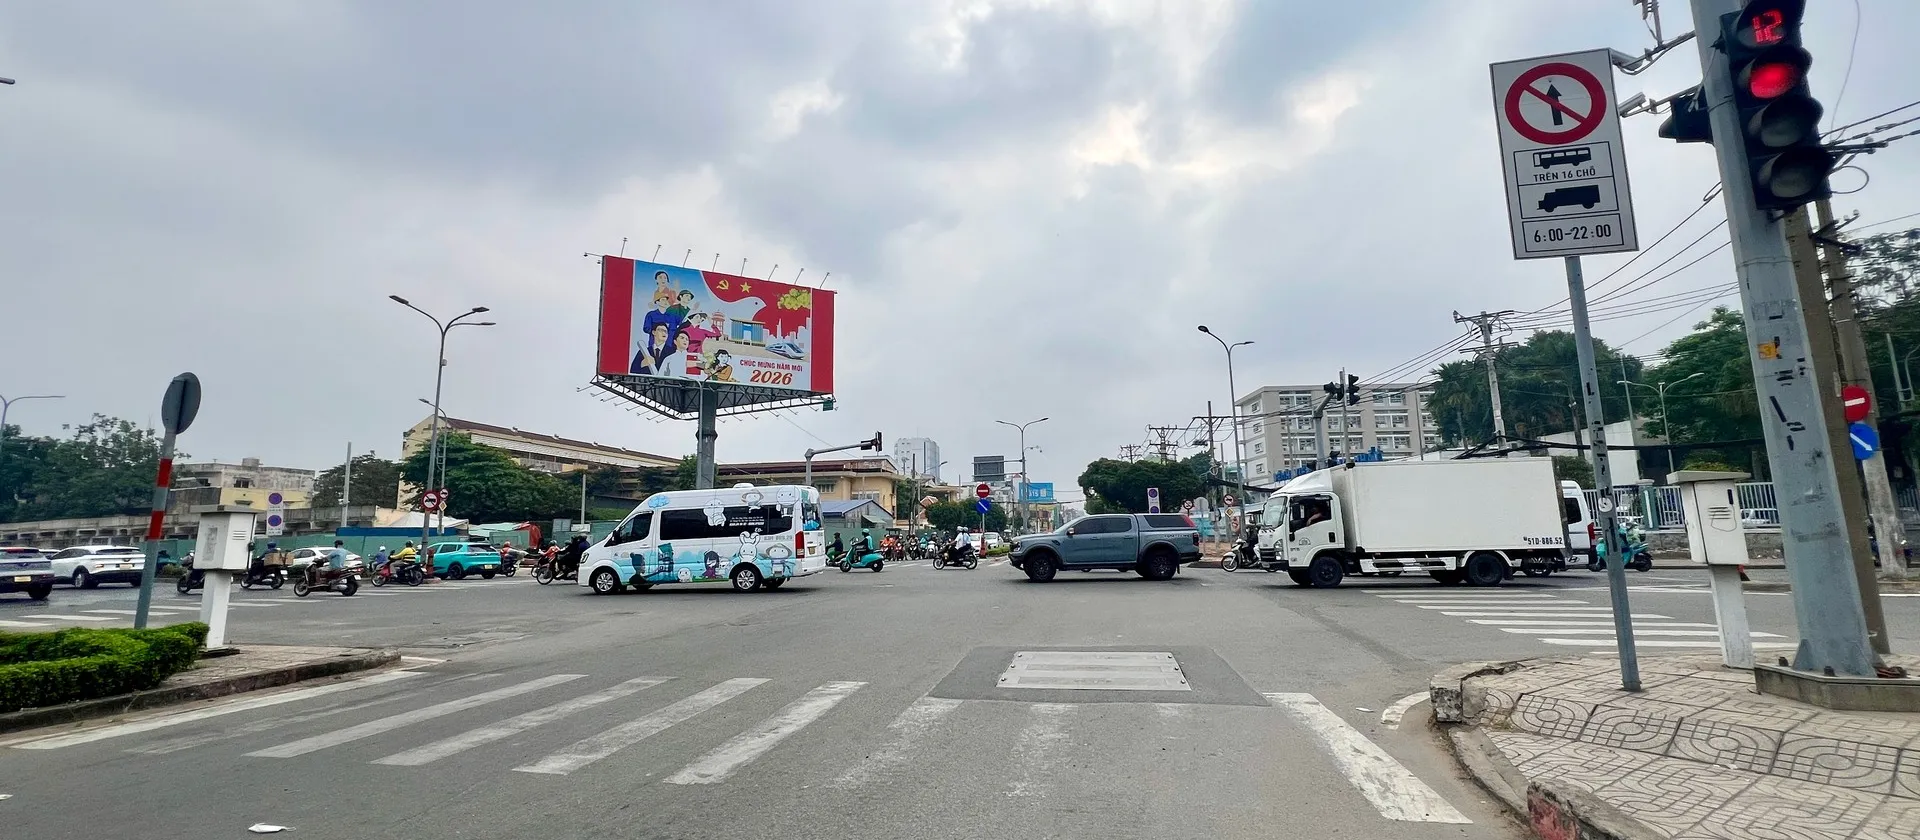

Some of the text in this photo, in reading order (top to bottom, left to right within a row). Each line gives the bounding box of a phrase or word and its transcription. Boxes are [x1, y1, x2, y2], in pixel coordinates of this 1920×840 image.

[1752, 10, 1782, 43] 12
[1533, 166, 1596, 182] TRÊN 16 CHỖ
[1534, 224, 1611, 243] 6:00-22:00
[750, 369, 793, 385] 2026
